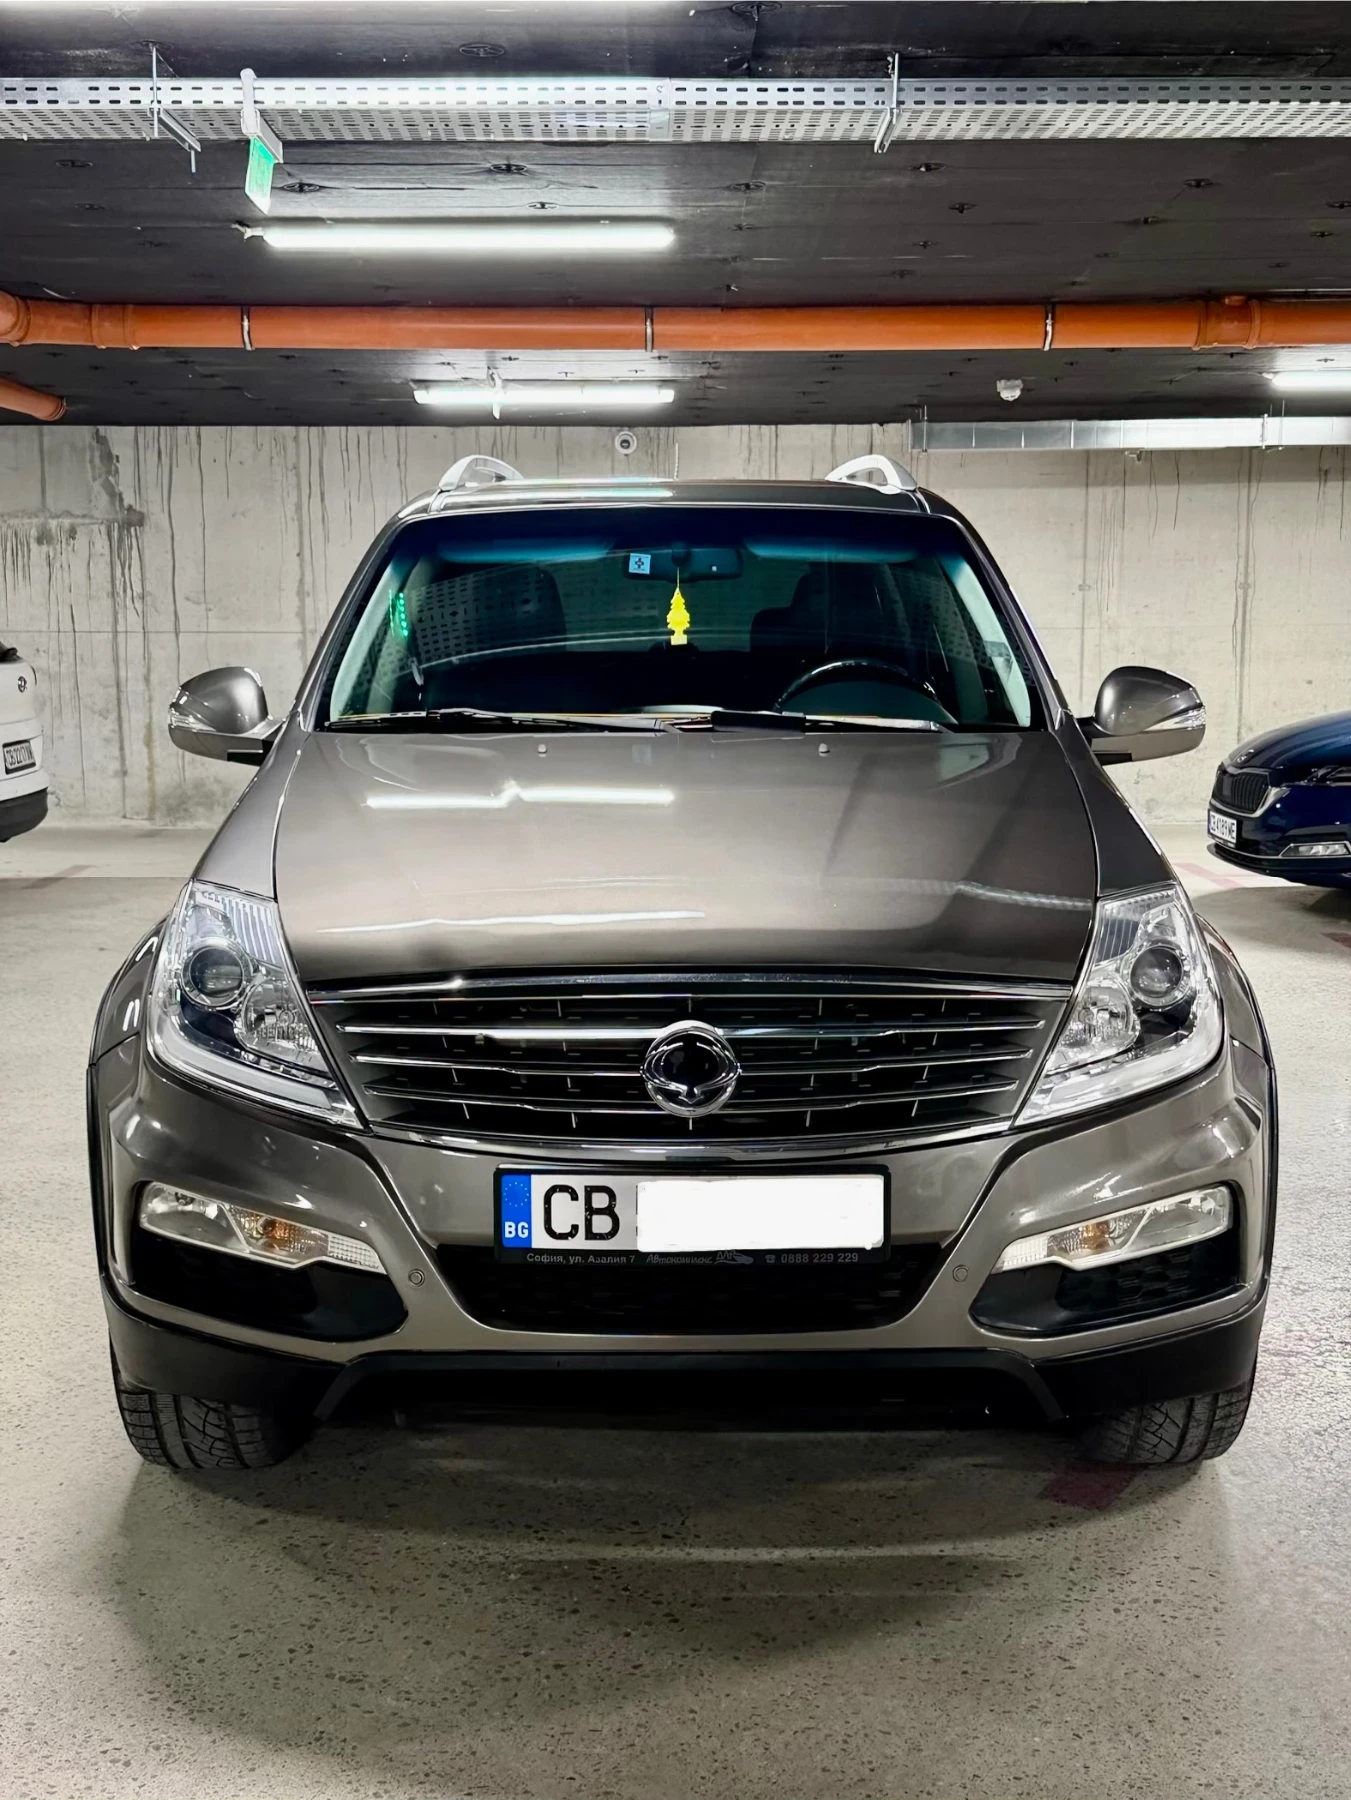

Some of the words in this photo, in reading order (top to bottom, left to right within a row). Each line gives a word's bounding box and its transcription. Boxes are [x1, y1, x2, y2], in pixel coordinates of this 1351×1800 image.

[543, 1184, 621, 1241] CB
[504, 1221, 529, 1239] BG
[526, 1252, 566, 1265] София,
[568, 1254, 585, 1265] ул.
[587, 1254, 627, 1264] Азалия
[628, 1254, 636, 1264] 7
[780, 1253, 810, 1264] 0888
[812, 1252, 834, 1263] 229
[837, 1252, 859, 1263] 229
